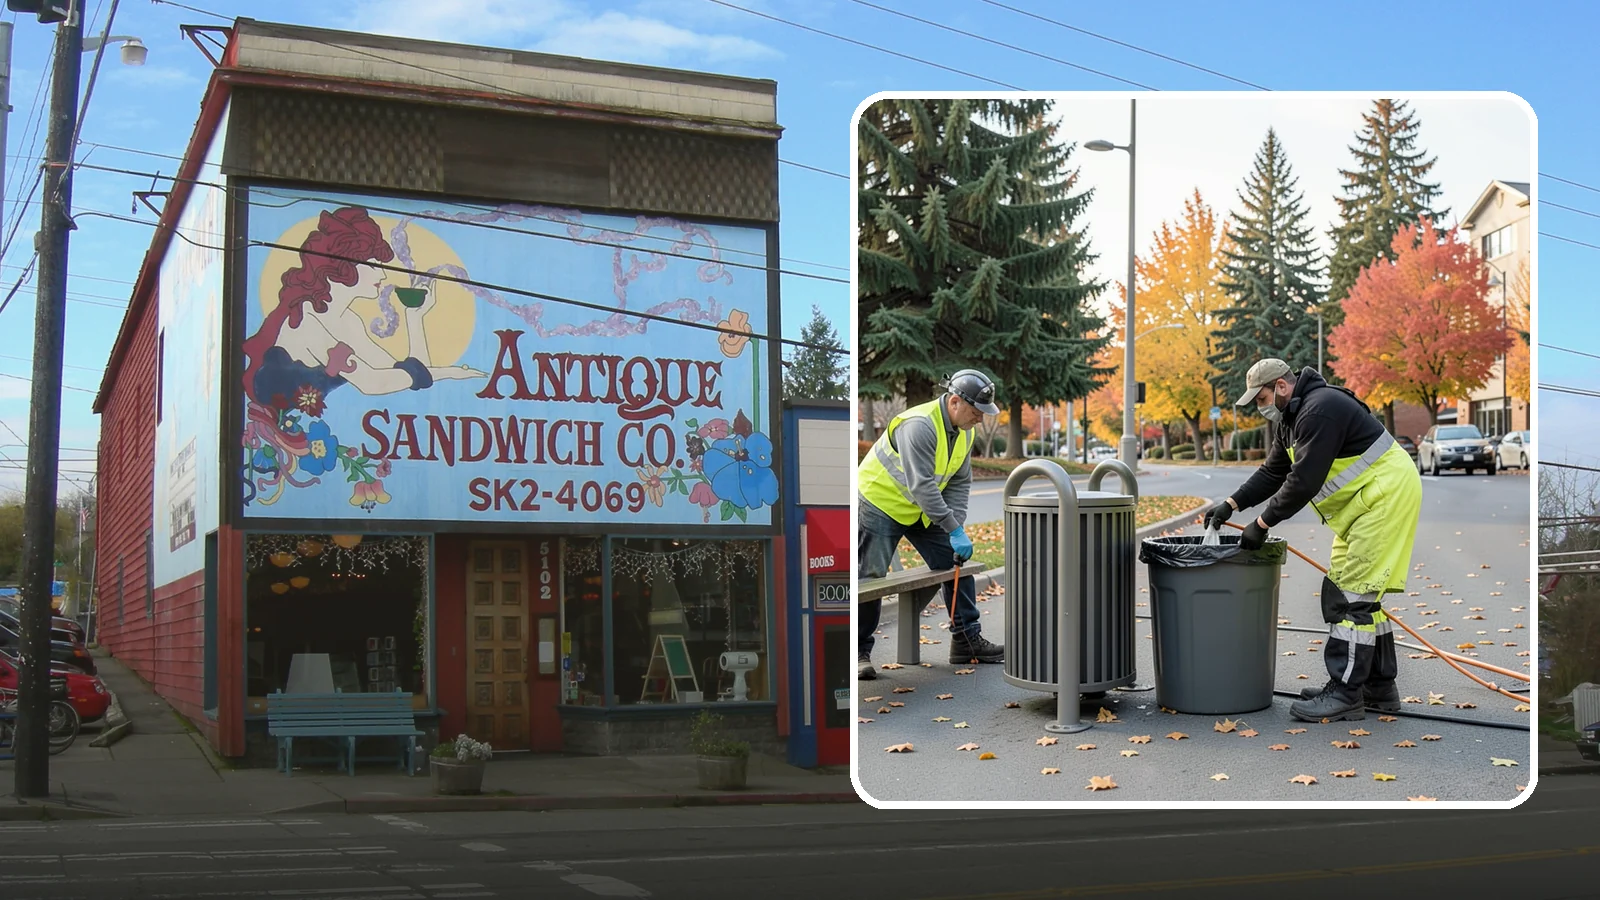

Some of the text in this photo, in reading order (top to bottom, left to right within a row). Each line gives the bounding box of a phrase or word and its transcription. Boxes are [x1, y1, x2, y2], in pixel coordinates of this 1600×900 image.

[476, 330, 723, 420] ANTIQUE
[362, 409, 686, 468] SANDWICH CO.
[469, 477, 646, 513] SK2-4069
[540, 542, 552, 600] 5102
[809, 555, 835, 569] BOOKS
